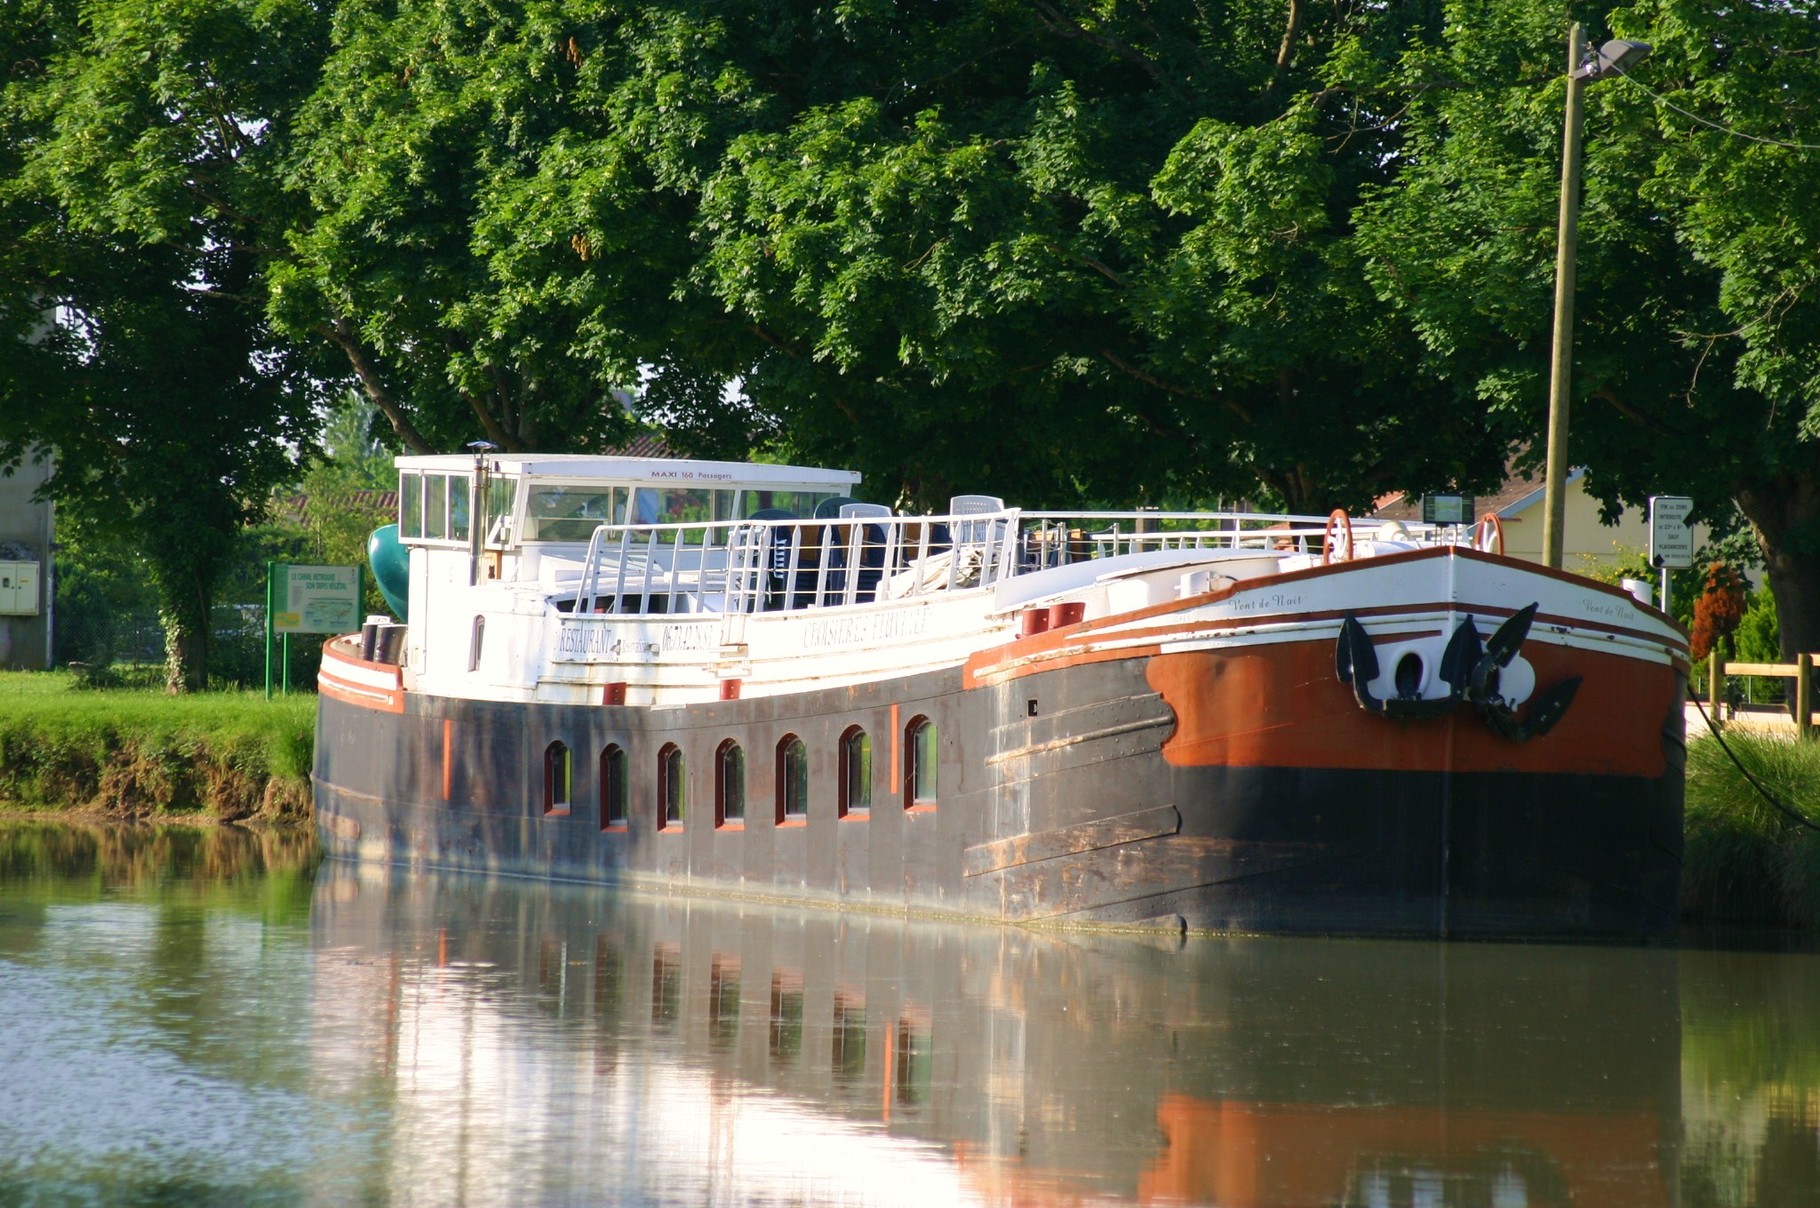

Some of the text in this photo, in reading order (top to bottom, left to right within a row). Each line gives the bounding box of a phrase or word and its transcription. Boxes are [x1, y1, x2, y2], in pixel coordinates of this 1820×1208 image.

[698, 472, 732, 480] Passagers
[305, 582, 315, 590] SON
[316, 582, 328, 590] TAPIS
[1229, 595, 1304, 611] Vent de Nuit
[1582, 599, 1634, 620] Vent de Nuit
[559, 627, 612, 654] RESTAURANT
